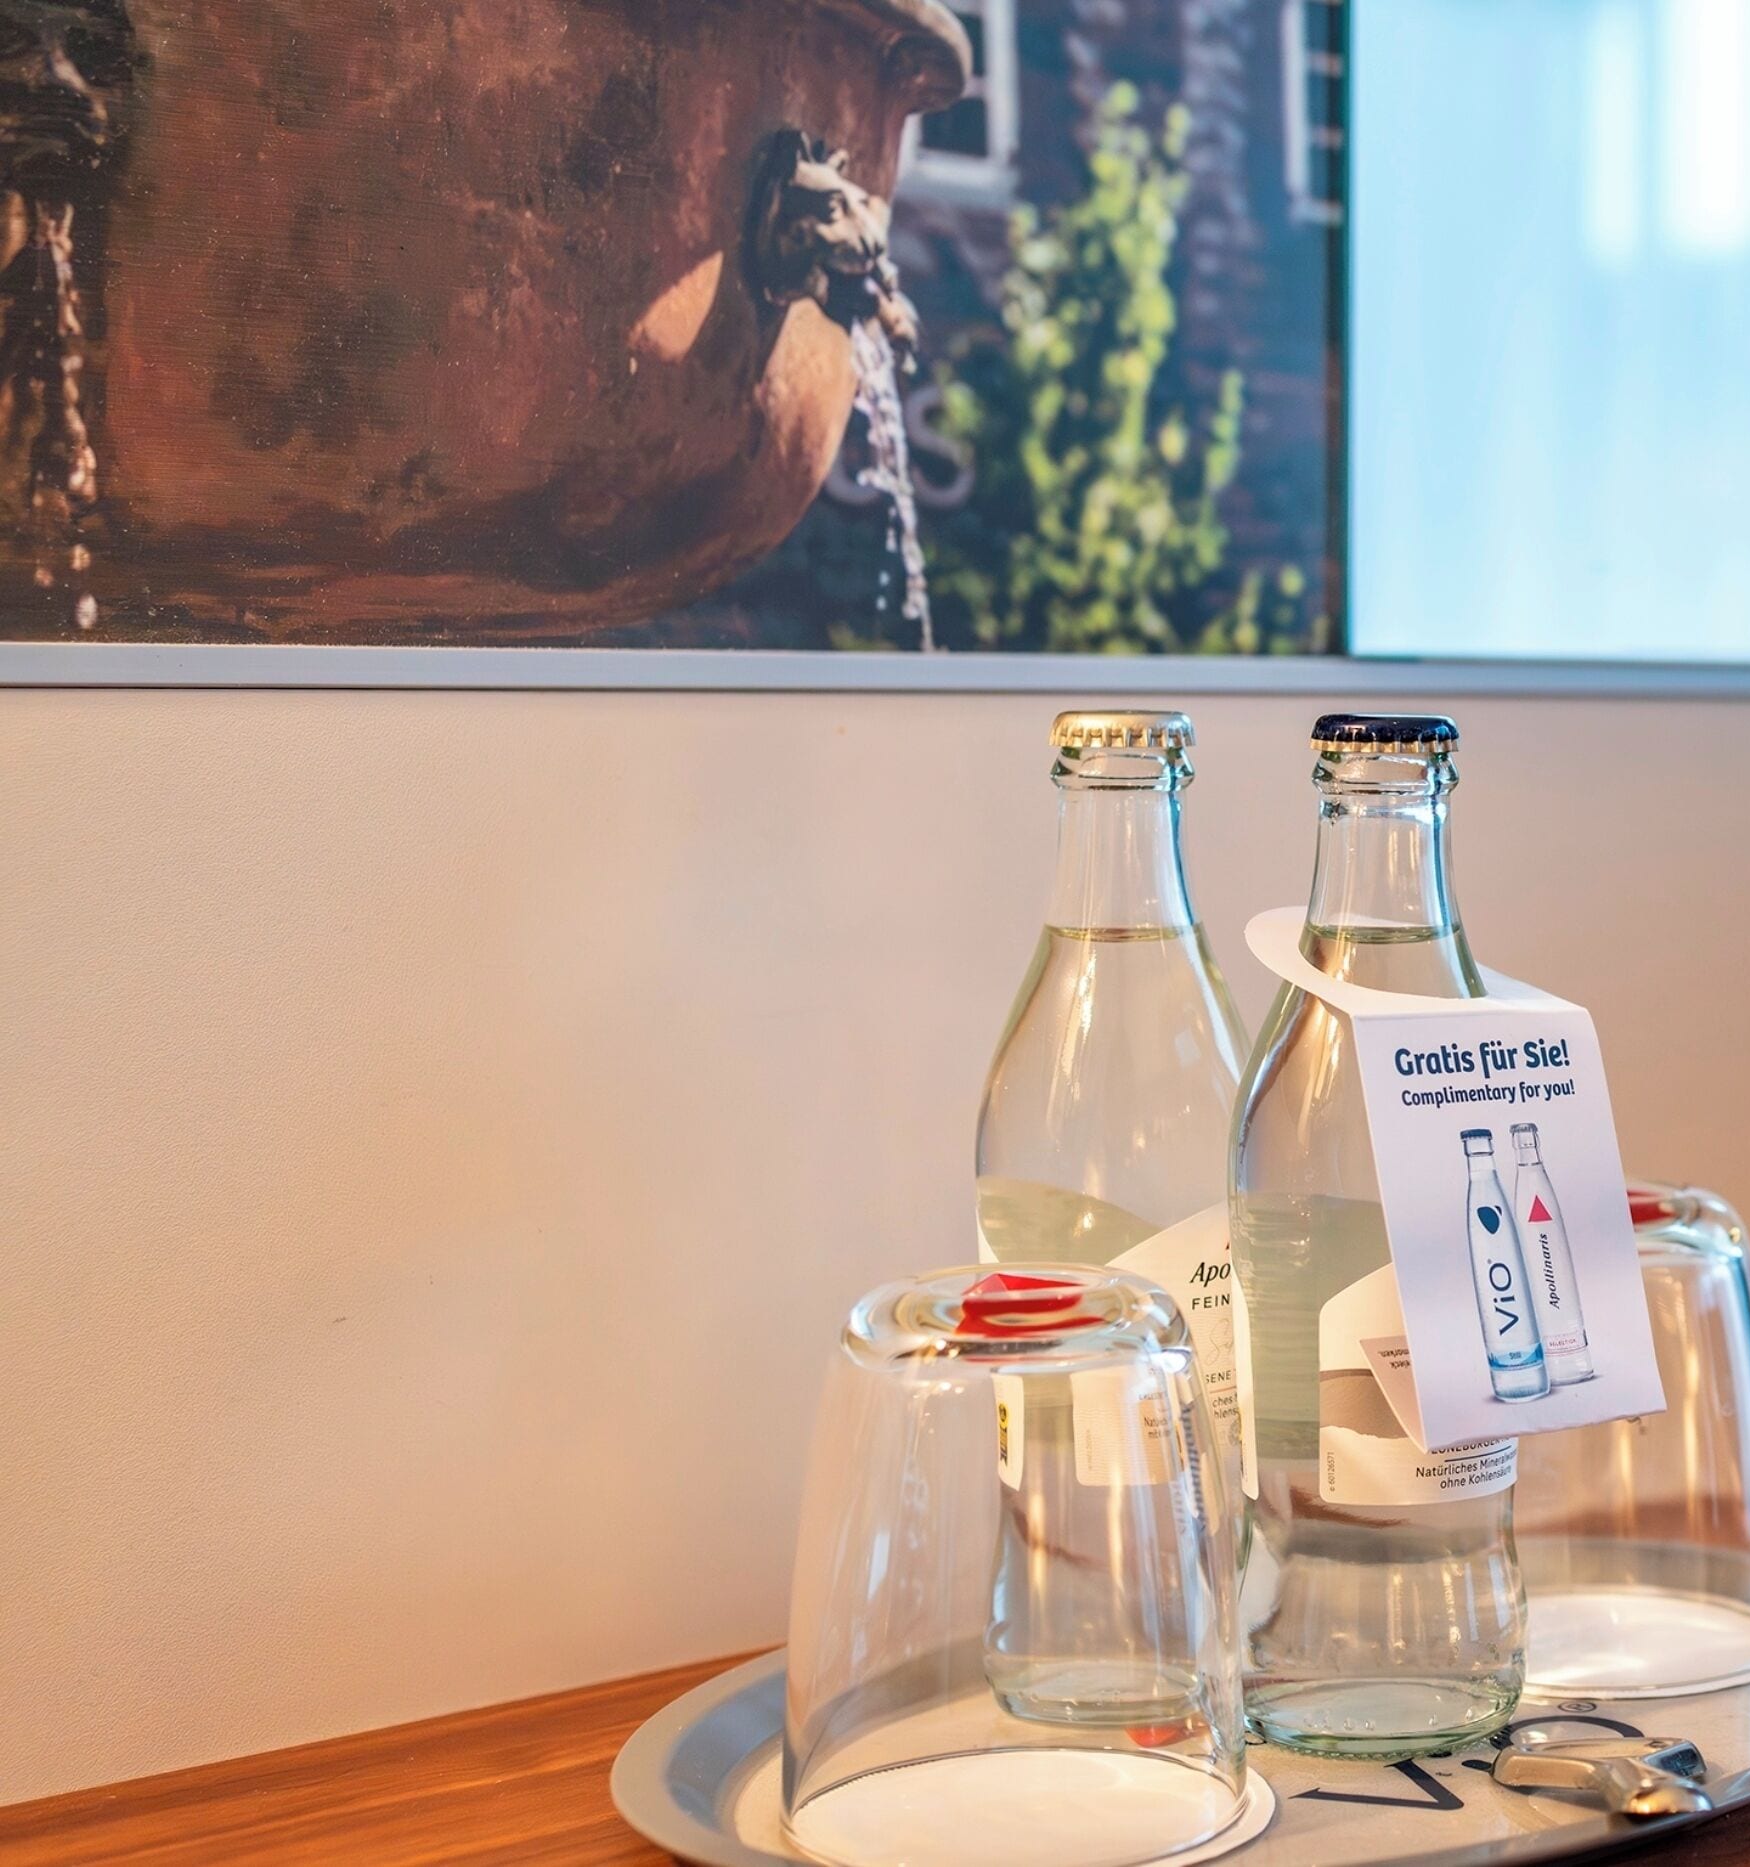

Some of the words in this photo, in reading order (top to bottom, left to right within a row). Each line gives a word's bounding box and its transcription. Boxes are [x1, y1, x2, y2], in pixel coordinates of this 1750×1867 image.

[1394, 1043, 1475, 1076] Gratis
[1479, 1040, 1518, 1079] für
[1523, 1038, 1571, 1068] Sie!
[1401, 1084, 1516, 1109] Complimentary
[1519, 1081, 1541, 1102] for
[1543, 1078, 1576, 1101] you!
[1538, 1233, 1561, 1310] Apollinaris
[1488, 1262, 1519, 1336] ViO
[1415, 1462, 1478, 1478] Natürliches
[1439, 1477, 1466, 1490] ohne
